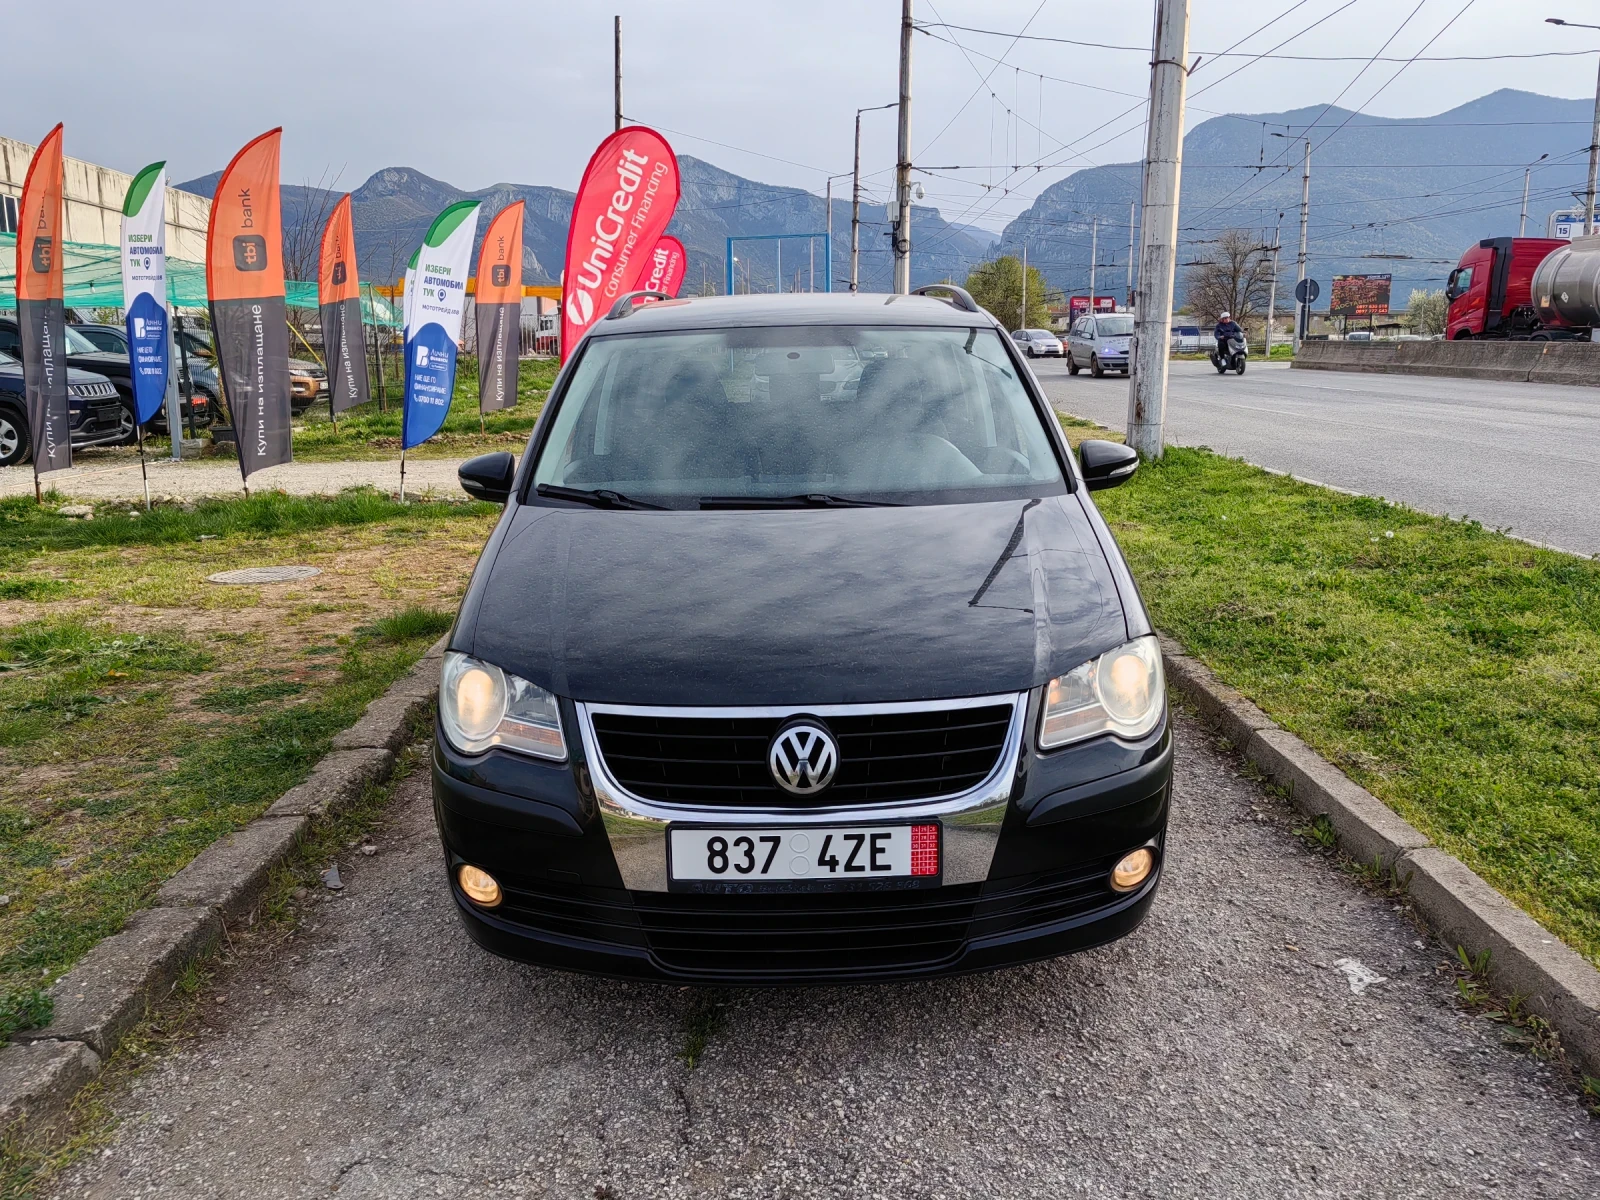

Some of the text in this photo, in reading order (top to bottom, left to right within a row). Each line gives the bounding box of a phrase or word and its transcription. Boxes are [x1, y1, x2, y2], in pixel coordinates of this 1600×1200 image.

[238, 188, 256, 264] tbi bank
[578, 149, 648, 288] UniCredit
[605, 162, 668, 297] Consumer Financing
[128, 234, 152, 242] ИЗБЕРИ
[425, 264, 452, 276] ИЗБЕРИ
[423, 288, 434, 297] ТУК
[424, 276, 463, 290] АВТОМОБИЛ
[345, 361, 352, 372] на
[497, 365, 502, 375] на
[252, 305, 267, 455] Купи на изплащане
[347, 375, 358, 398] Купи
[496, 378, 504, 400] Купи
[46, 422, 56, 457] Купи
[707, 833, 891, 874] 837 4ZE
